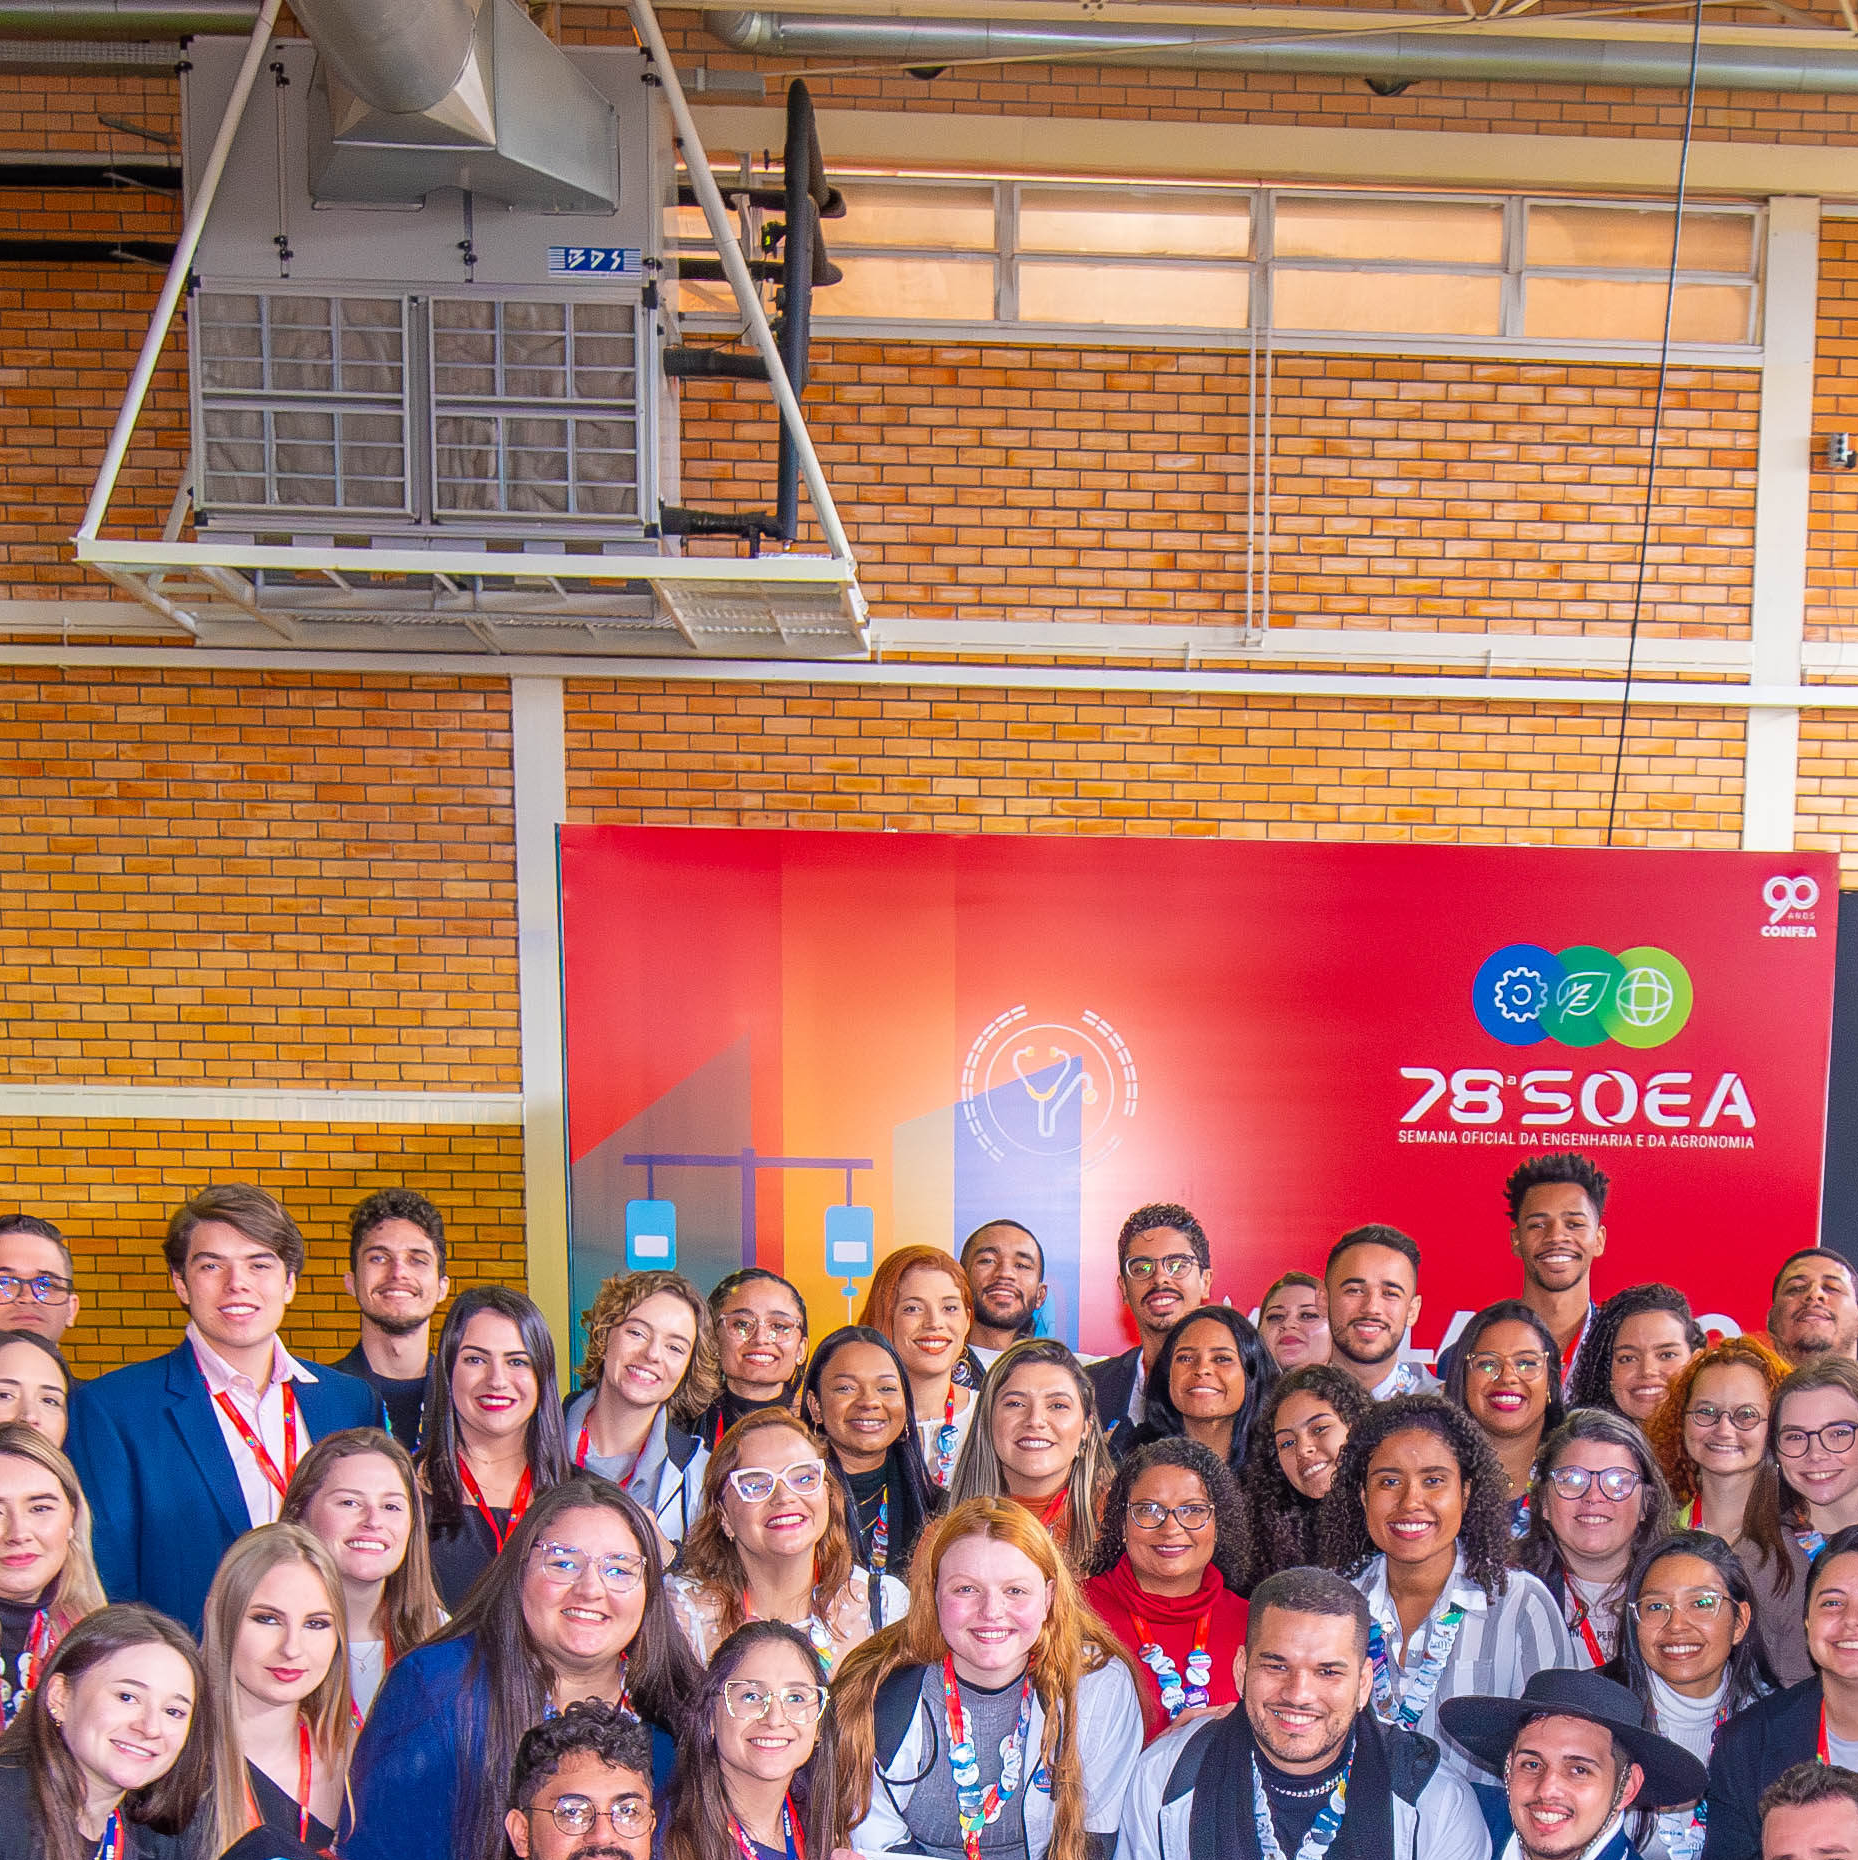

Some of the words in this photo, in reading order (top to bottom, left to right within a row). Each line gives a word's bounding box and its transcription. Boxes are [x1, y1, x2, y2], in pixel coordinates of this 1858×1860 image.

[1763, 875, 1820, 924] 90
[1760, 925, 1817, 938] CONFEA
[1398, 1130, 1458, 1145] SEMANA
[1461, 1131, 1515, 1146] OFICIAL
[1520, 1132, 1539, 1146] DA
[1542, 1133, 1633, 1148] ENGENHARIA
[1636, 1135, 1644, 1148] E
[1648, 1135, 1668, 1148] DA
[1670, 1135, 1755, 1150] AGRONOMIA
